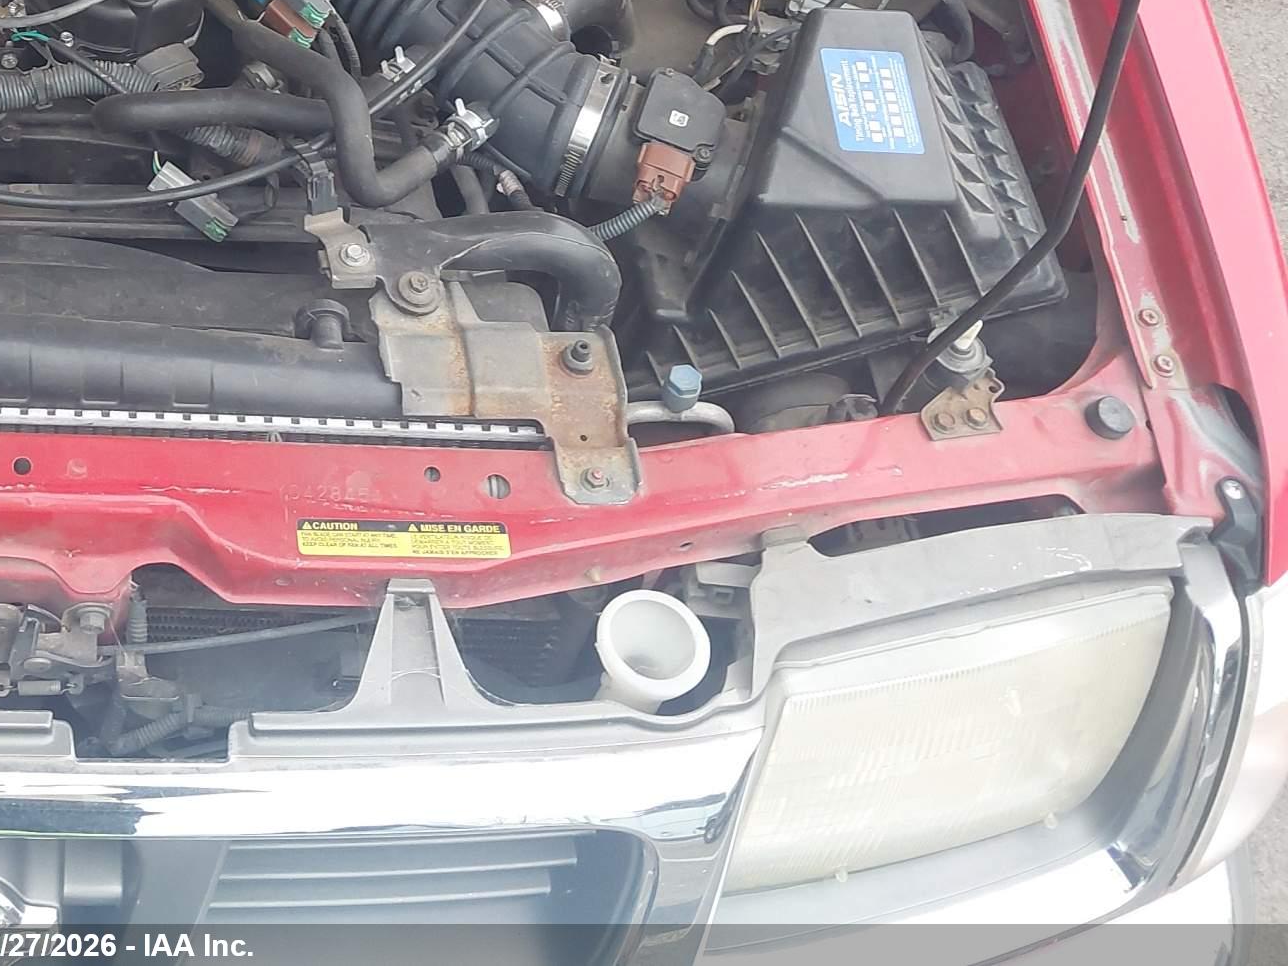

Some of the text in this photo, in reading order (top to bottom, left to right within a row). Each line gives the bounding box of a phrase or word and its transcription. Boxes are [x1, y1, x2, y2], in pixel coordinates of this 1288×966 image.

[830, 72, 852, 128] AISIN
[312, 521, 358, 530] CAUTION
[420, 524, 501, 534] MISE EN GARDE
